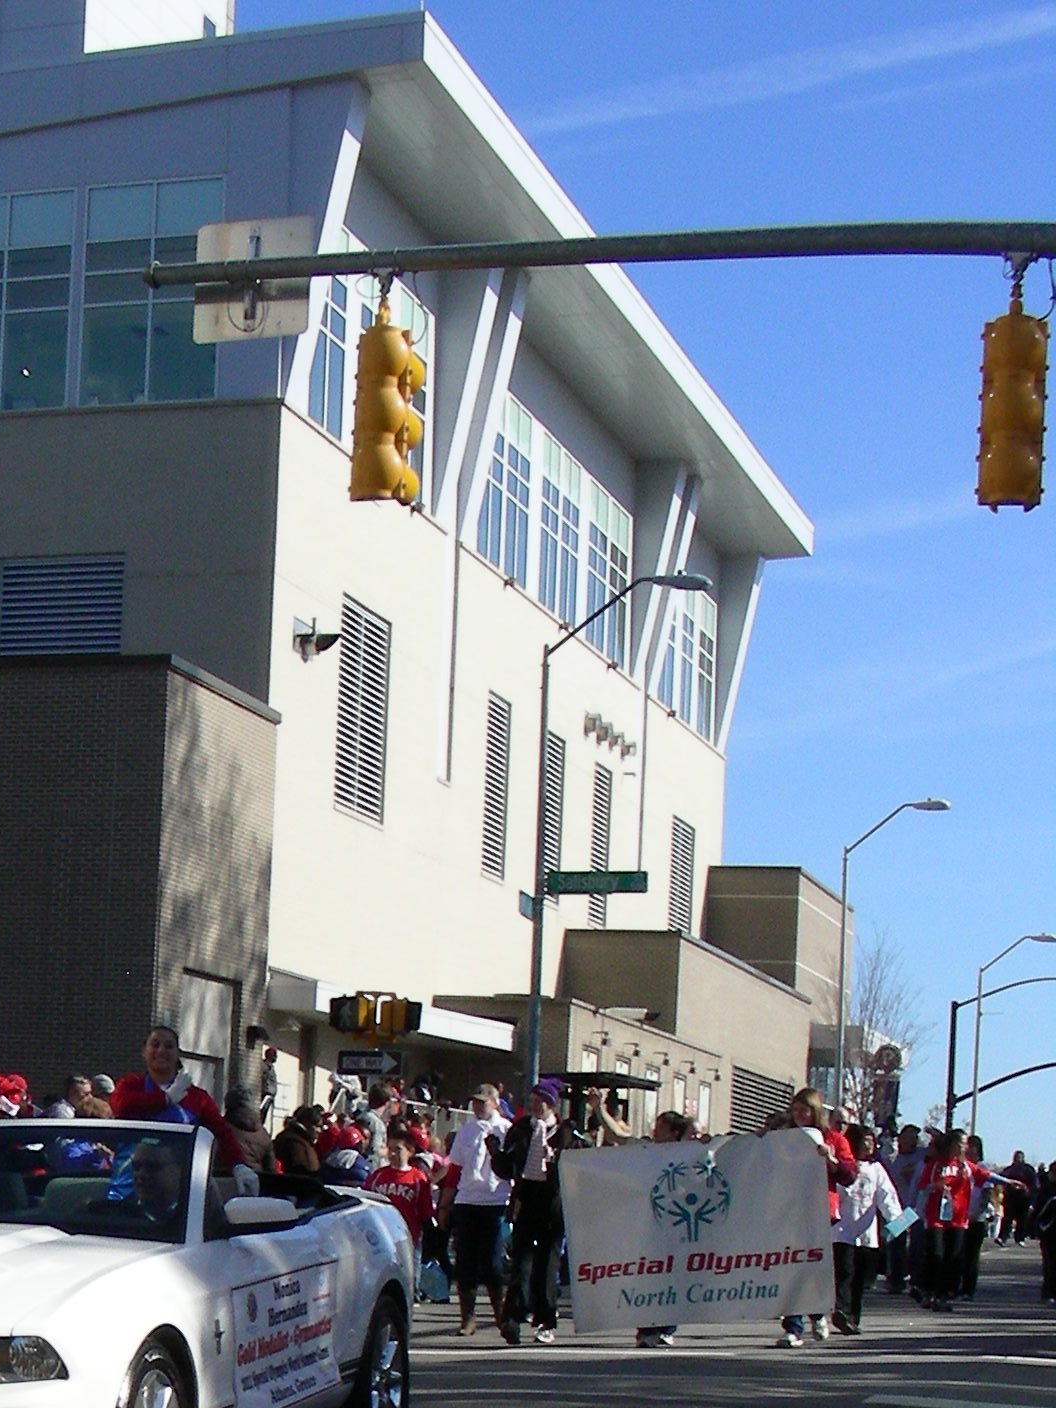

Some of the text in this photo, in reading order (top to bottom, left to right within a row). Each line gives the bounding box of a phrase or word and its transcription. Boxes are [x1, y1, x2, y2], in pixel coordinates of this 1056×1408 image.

[557, 874, 620, 891] Salisbury
[577, 1246, 825, 1284] Special Olympics
[617, 1279, 780, 1308] North Carolina
[237, 1340, 257, 1367] Gold
